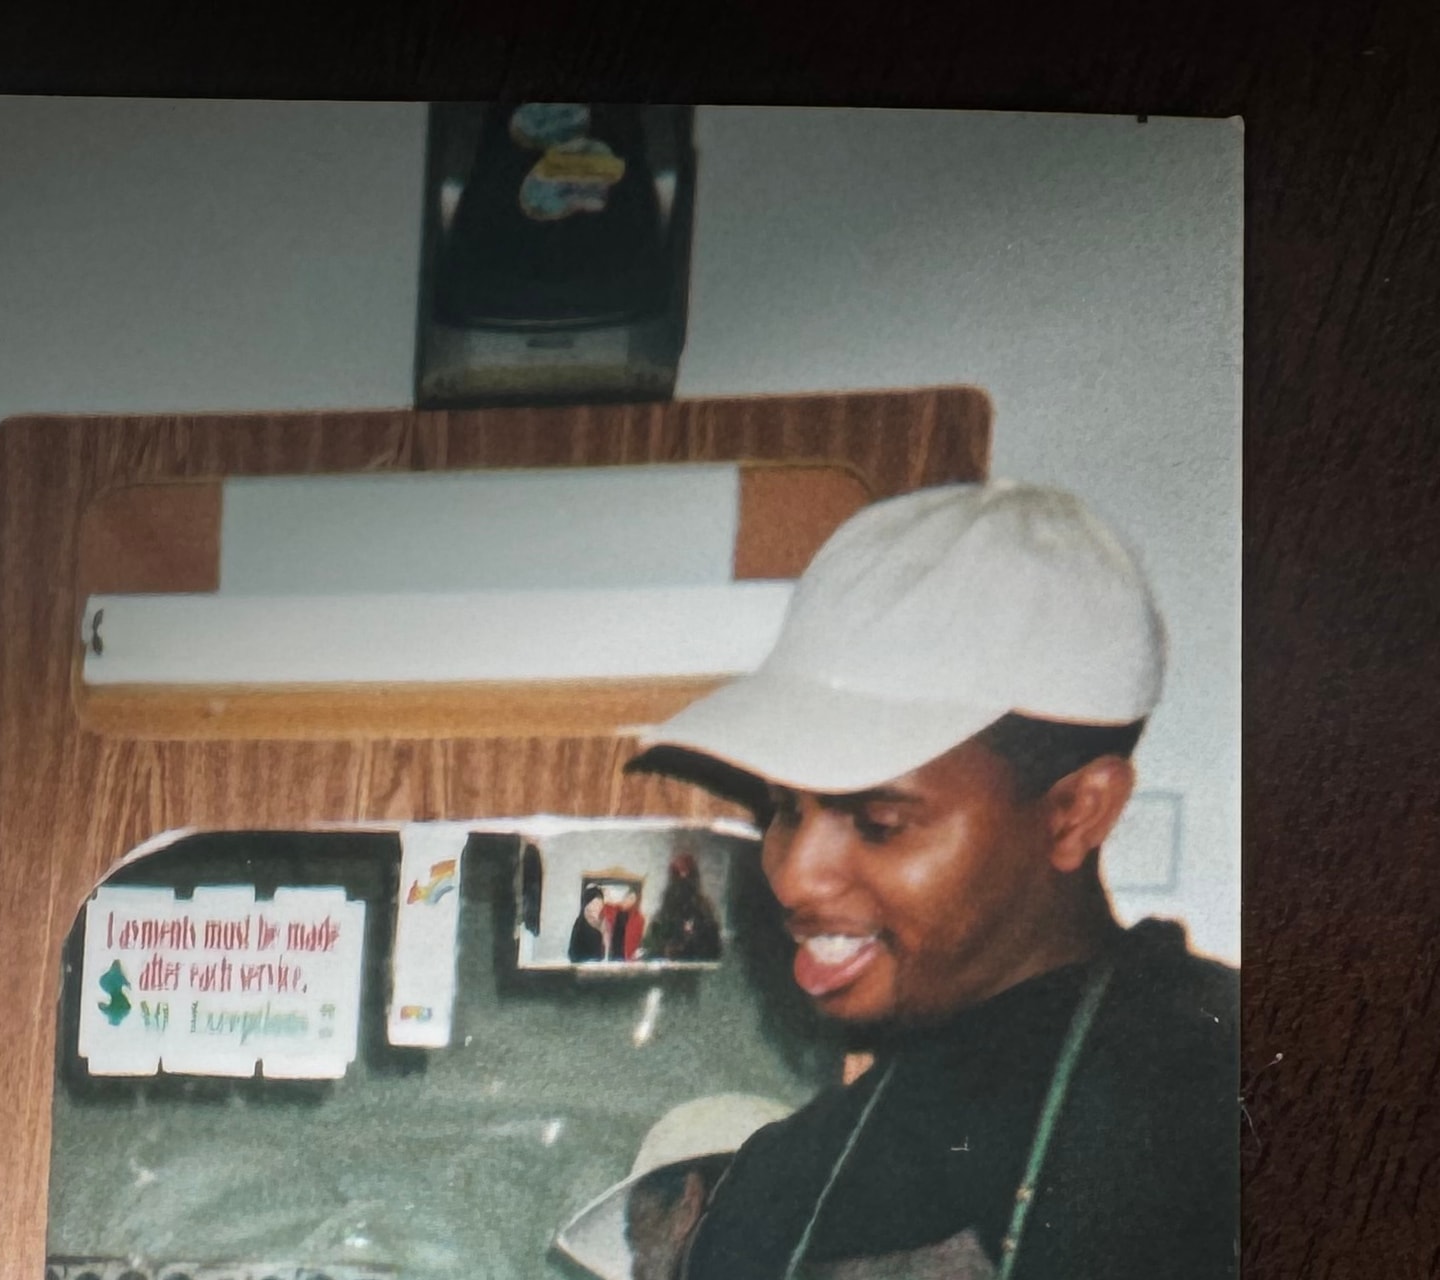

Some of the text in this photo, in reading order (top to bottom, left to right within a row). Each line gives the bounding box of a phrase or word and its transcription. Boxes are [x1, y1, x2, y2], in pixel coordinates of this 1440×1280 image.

[203, 914, 251, 951] must
[257, 914, 280, 951] be
[287, 914, 340, 952] made
[139, 952, 179, 992] after
